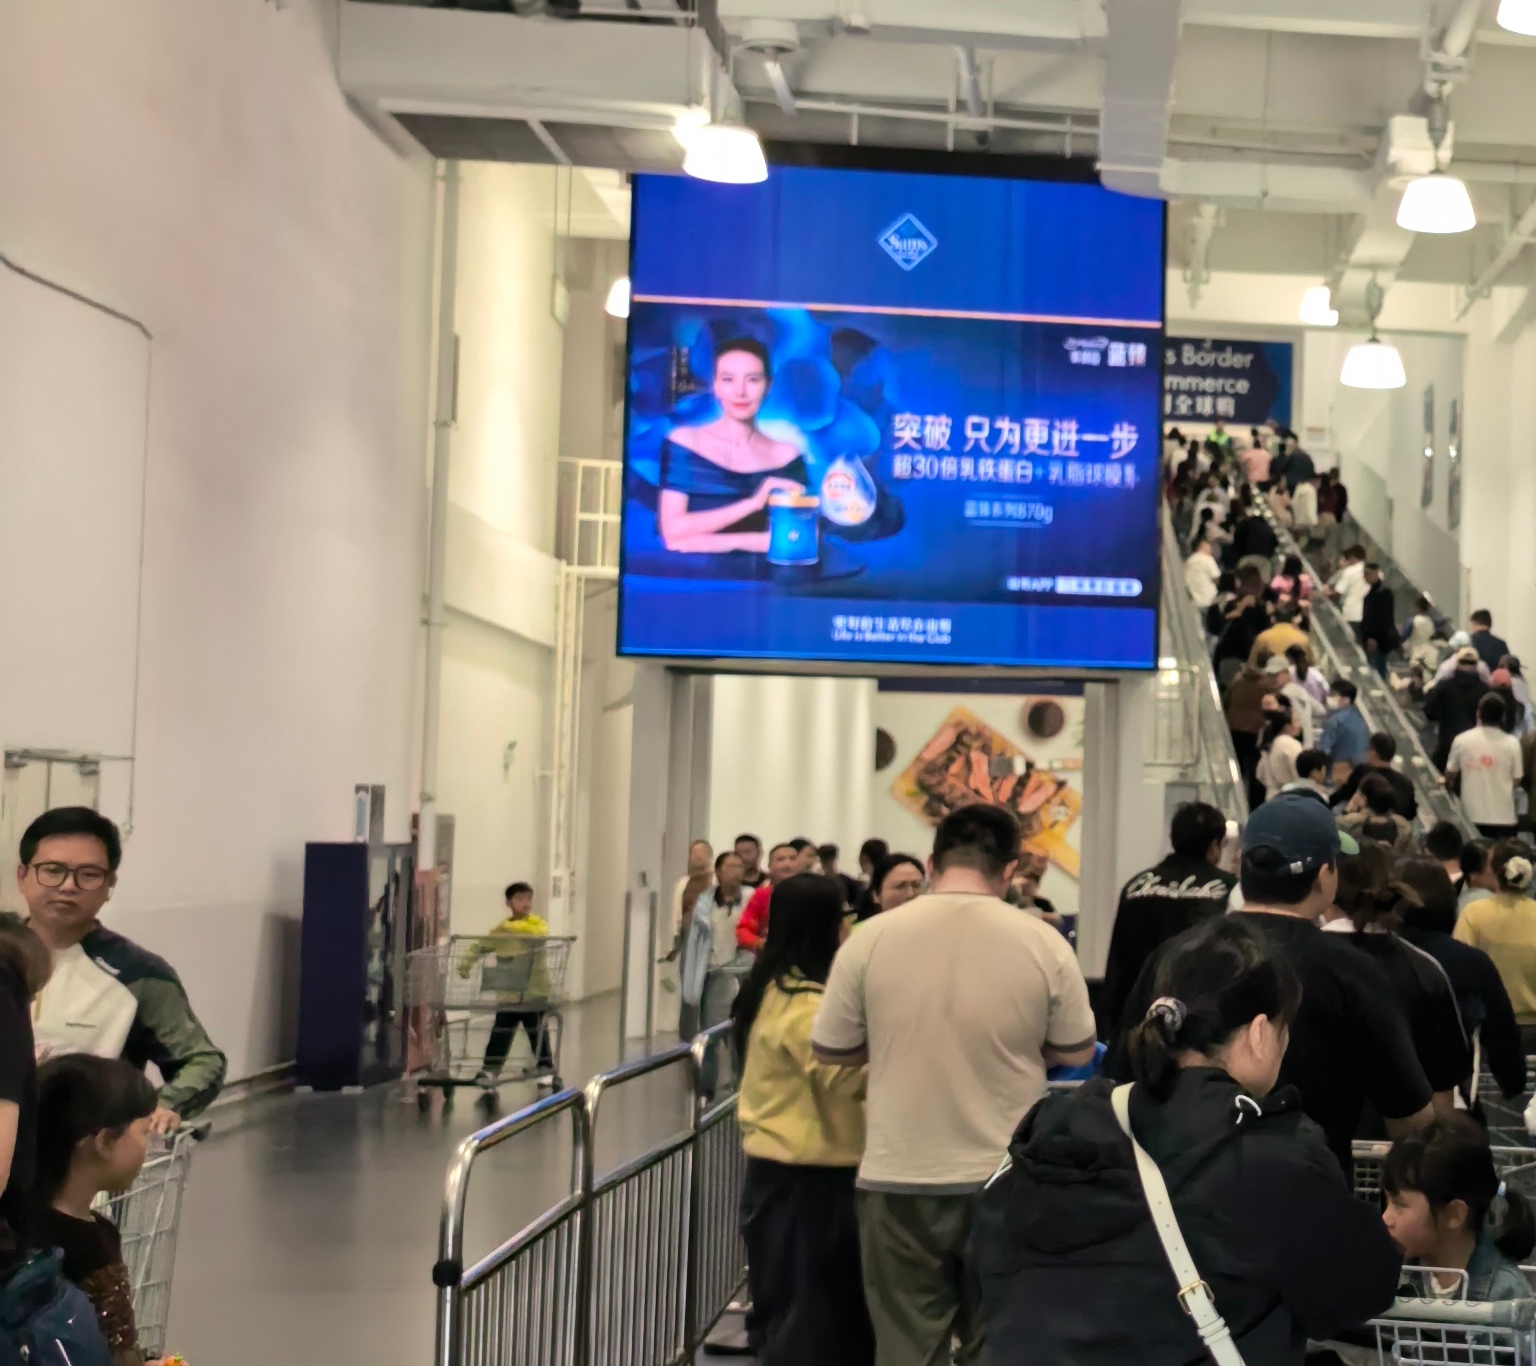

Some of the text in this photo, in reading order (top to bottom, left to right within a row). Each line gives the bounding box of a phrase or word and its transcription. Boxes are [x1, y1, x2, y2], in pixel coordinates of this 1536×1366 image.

[1181, 342, 1255, 370] Border
[892, 413, 1140, 459] 突破 只为更进一步
